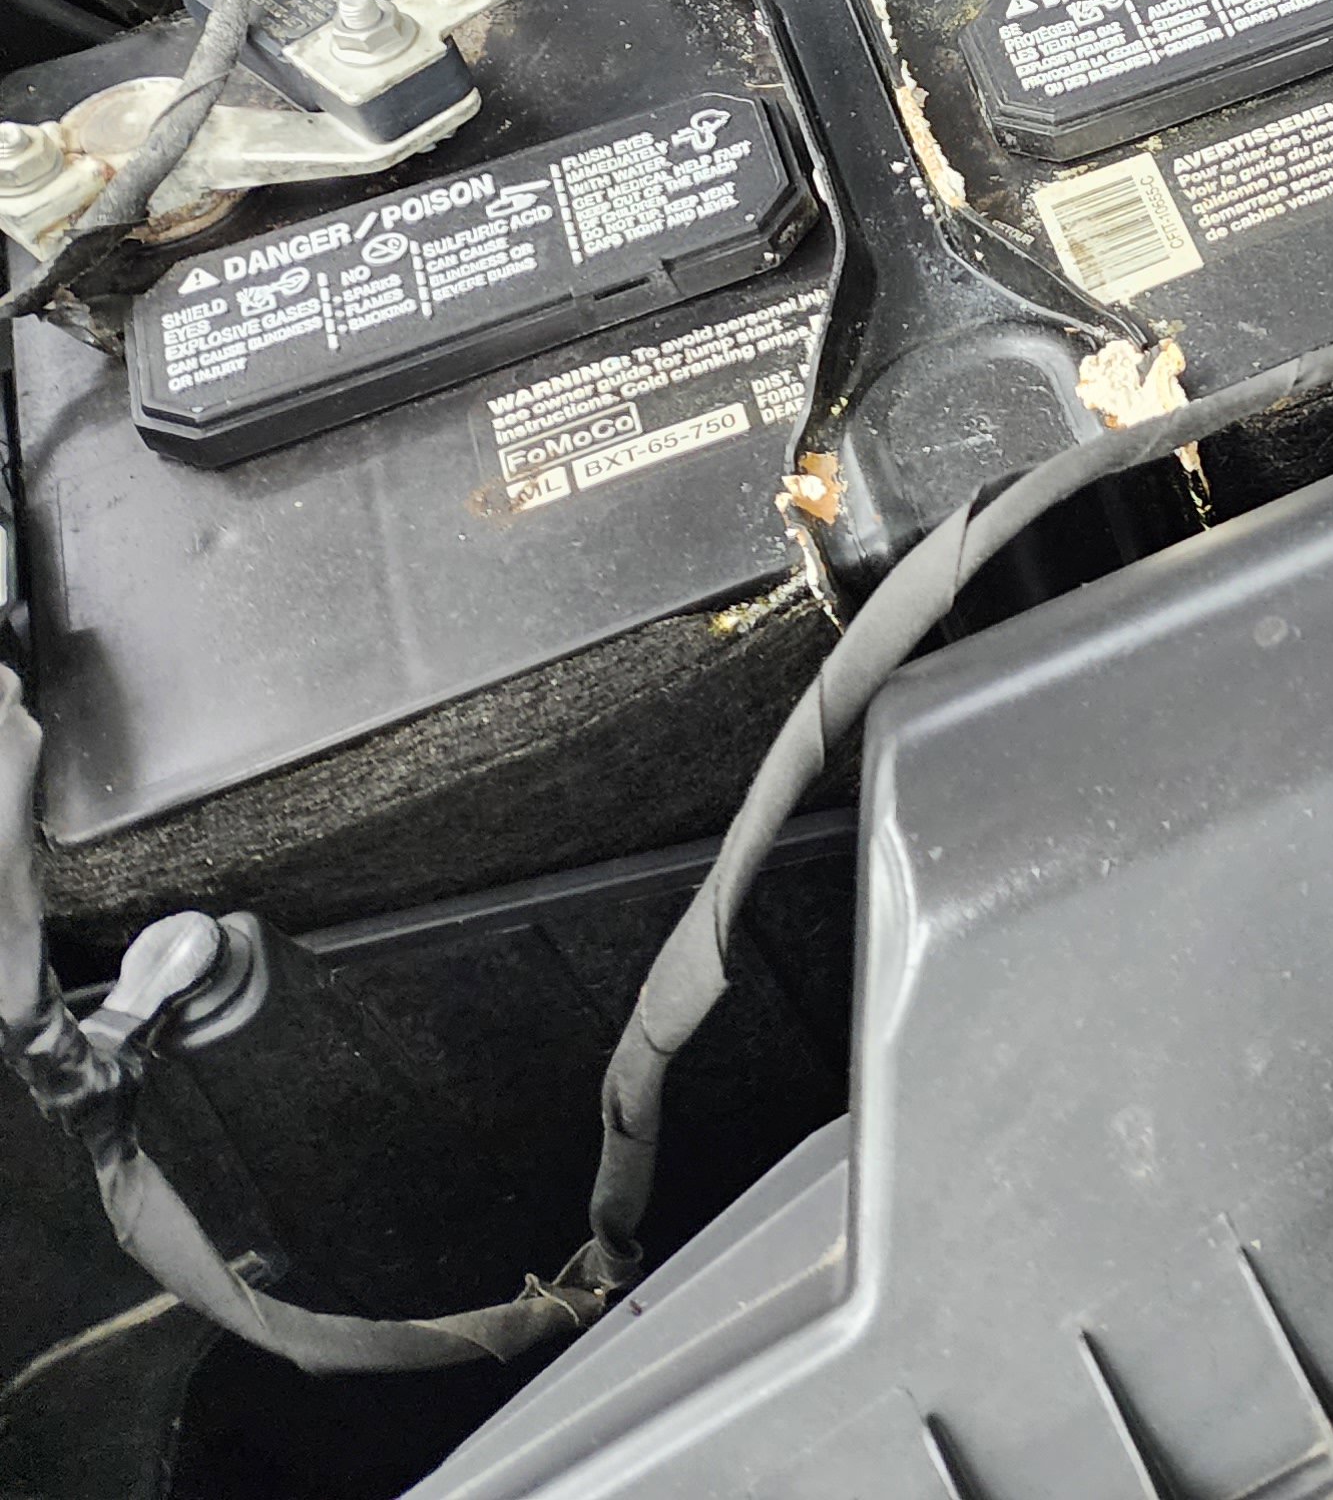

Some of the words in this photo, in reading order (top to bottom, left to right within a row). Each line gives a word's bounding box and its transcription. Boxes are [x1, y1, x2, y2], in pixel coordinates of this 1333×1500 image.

[1007, 45, 1041, 66] LES
[561, 143, 612, 173] FLUSH
[565, 138, 670, 186] IMMEDIATELY
[1182, 176, 1220, 202] Voir
[1285, 143, 1310, 162] du
[568, 172, 611, 199] WITH
[571, 188, 606, 212] GET
[607, 166, 673, 200] MEDICAL
[672, 152, 712, 178] HELP
[1176, 162, 1220, 188] Pour
[612, 190, 642, 210] OUT
[421, 216, 509, 260] SULFURIC
[508, 201, 553, 232] ACID
[1203, 222, 1229, 243] de
[425, 252, 458, 274] CAN
[459, 235, 509, 263] CAUSE
[340, 262, 371, 288] NO
[342, 271, 402, 304] SPARKS
[160, 294, 228, 332] SHIELD
[345, 286, 404, 318] FLAMES
[162, 317, 211, 347] EYES
[164, 316, 262, 363] EXPLOSIVE
[261, 296, 321, 331] GASES
[634, 341, 663, 364] To
[660, 322, 718, 355] avoid
[166, 355, 198, 378] CAN
[167, 372, 193, 392] OR
[490, 405, 529, 432] see
[531, 382, 597, 417] owner
[596, 361, 655, 396] guide
[652, 349, 684, 374] for
[682, 332, 736, 367] jump
[620, 369, 669, 400] Cold
[668, 340, 757, 387] cranking
[755, 380, 805, 410] FORD
[504, 409, 636, 475] FoMoCo
[583, 411, 738, 479] BXT-65-750
